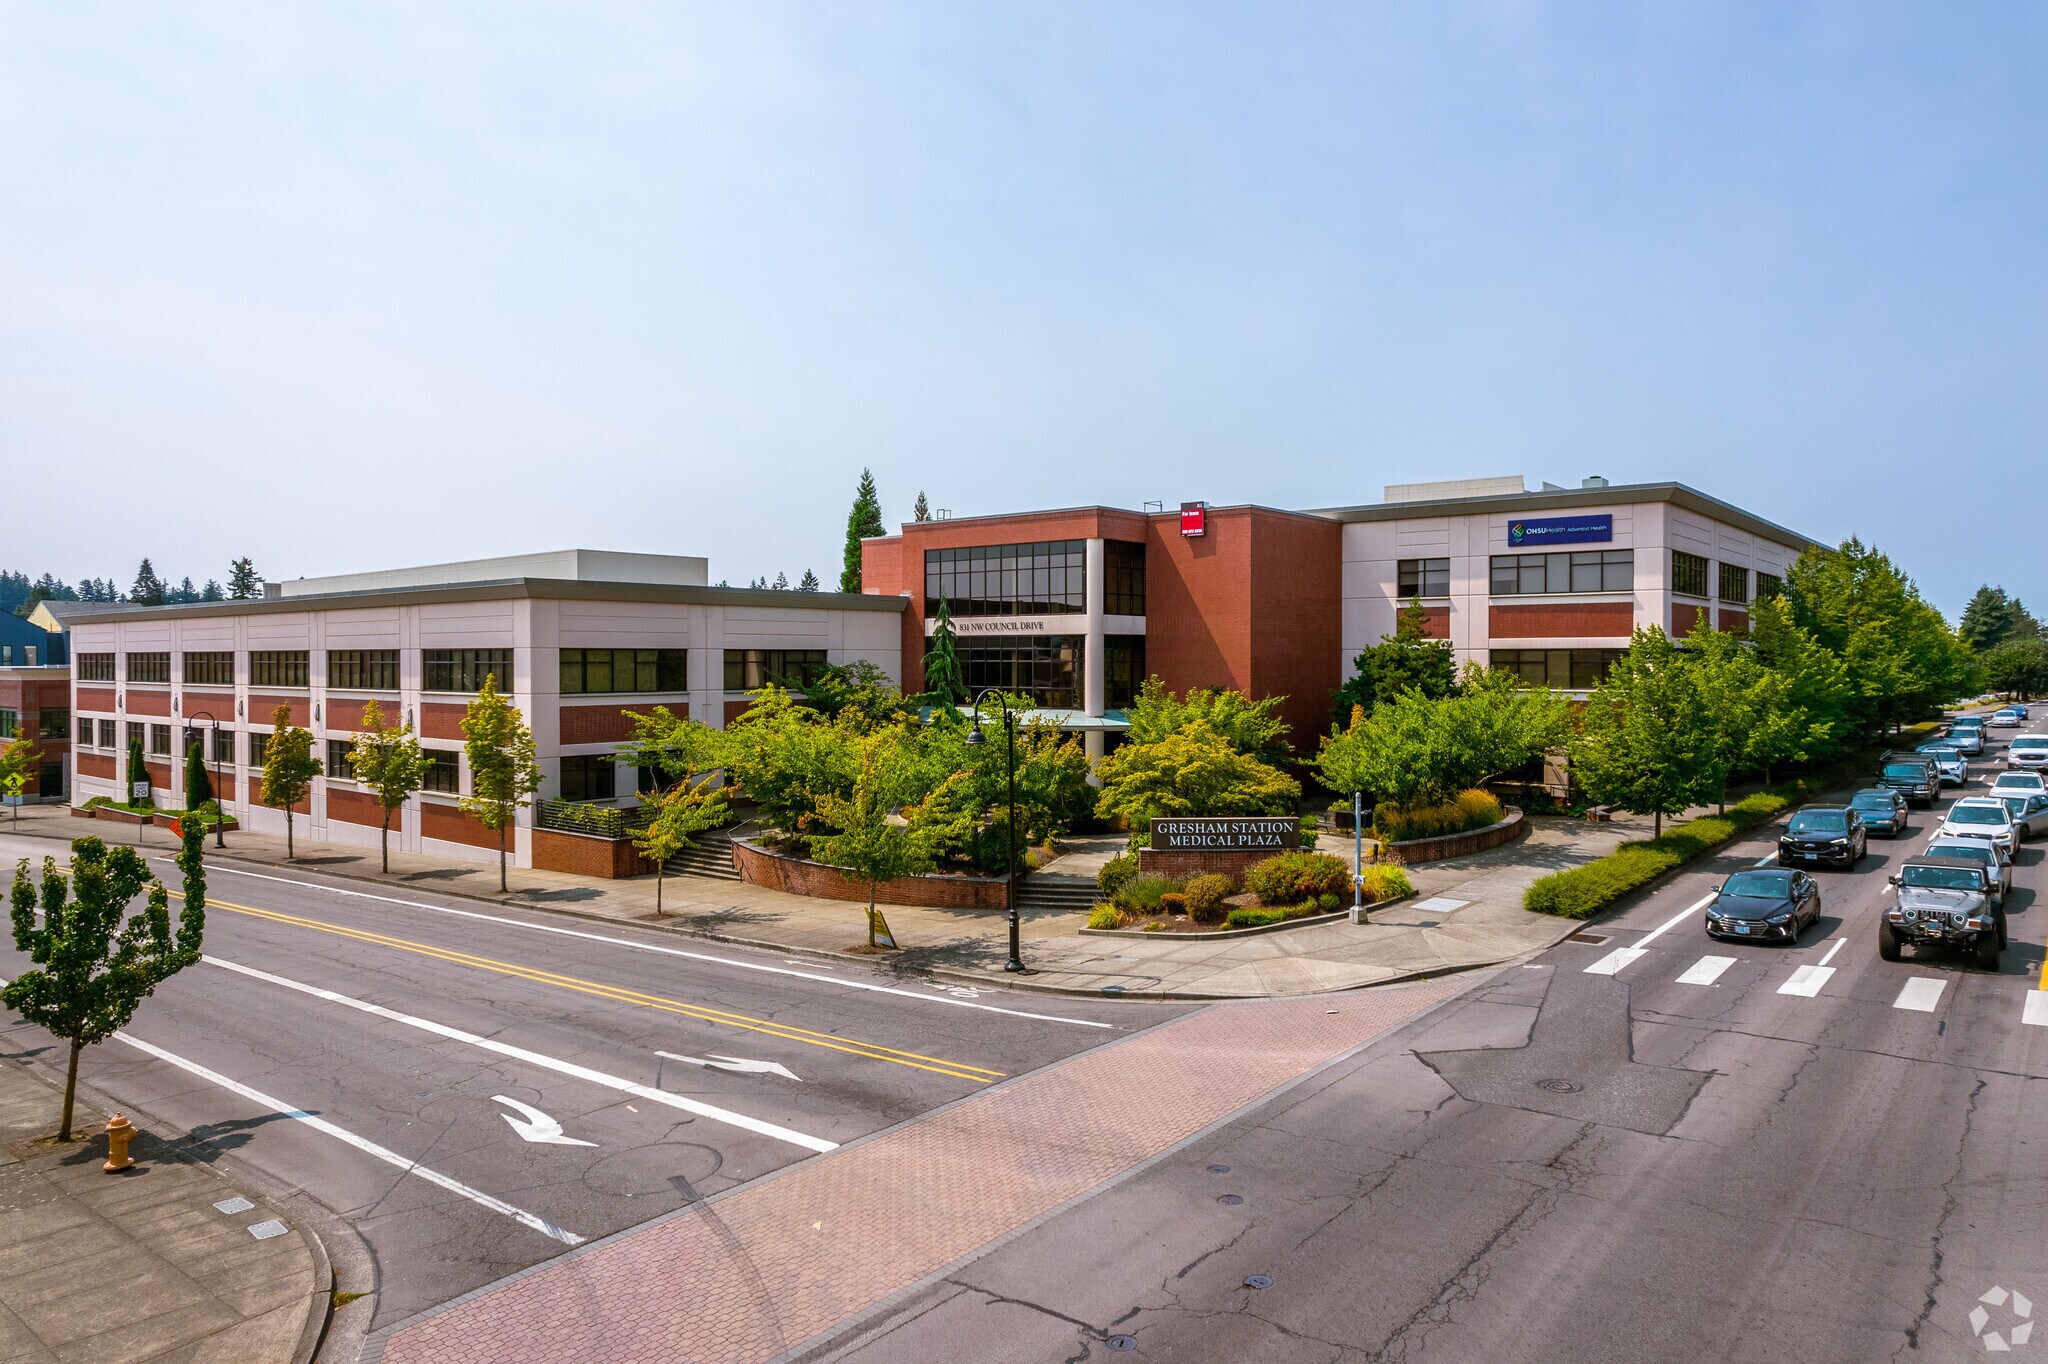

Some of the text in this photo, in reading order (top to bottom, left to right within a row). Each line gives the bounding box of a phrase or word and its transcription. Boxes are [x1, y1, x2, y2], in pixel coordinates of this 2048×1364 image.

[959, 621, 1044, 632] 831 NW COUNCIL DRIVE
[1157, 822, 1294, 834] GRESHAM STATION
[1169, 834, 1283, 846] MEDICAL PLAZA
